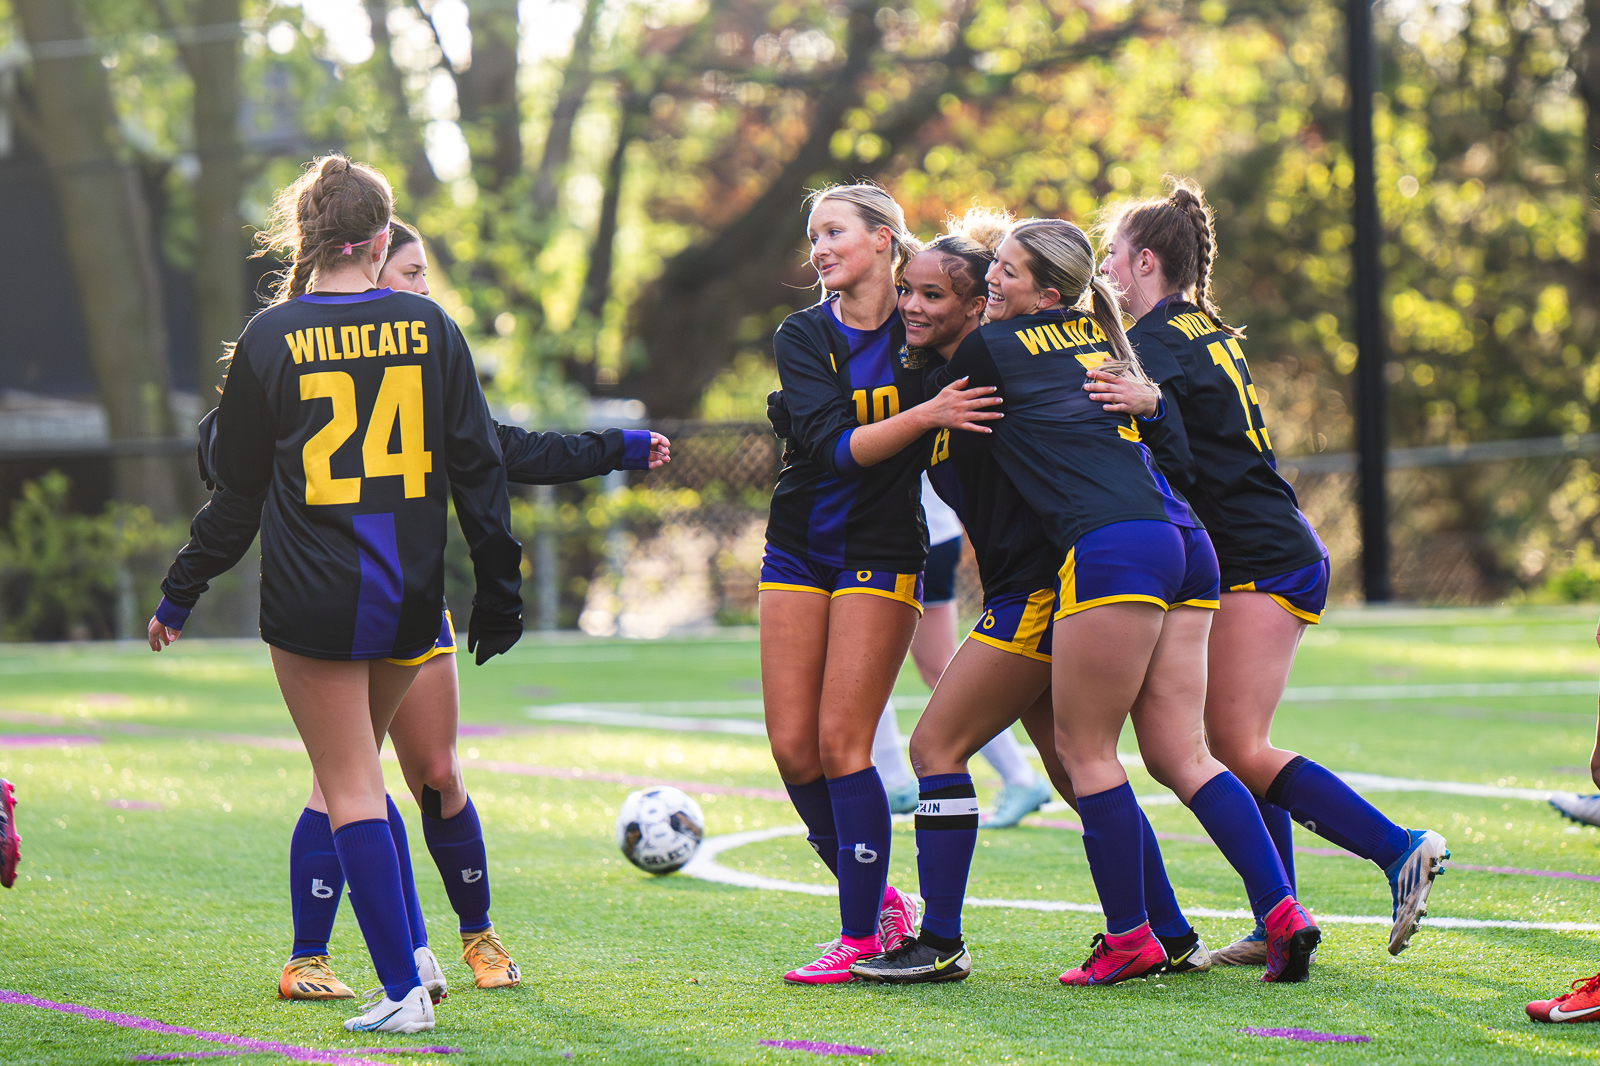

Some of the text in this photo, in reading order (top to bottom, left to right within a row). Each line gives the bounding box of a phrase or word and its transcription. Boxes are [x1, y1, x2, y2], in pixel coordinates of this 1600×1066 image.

[284, 320, 428, 365] WILDCATS
[1014, 315, 1109, 356] WILDCA
[1167, 310, 1222, 340] WILD
[852, 385, 900, 425] 10
[299, 364, 432, 505] 24
